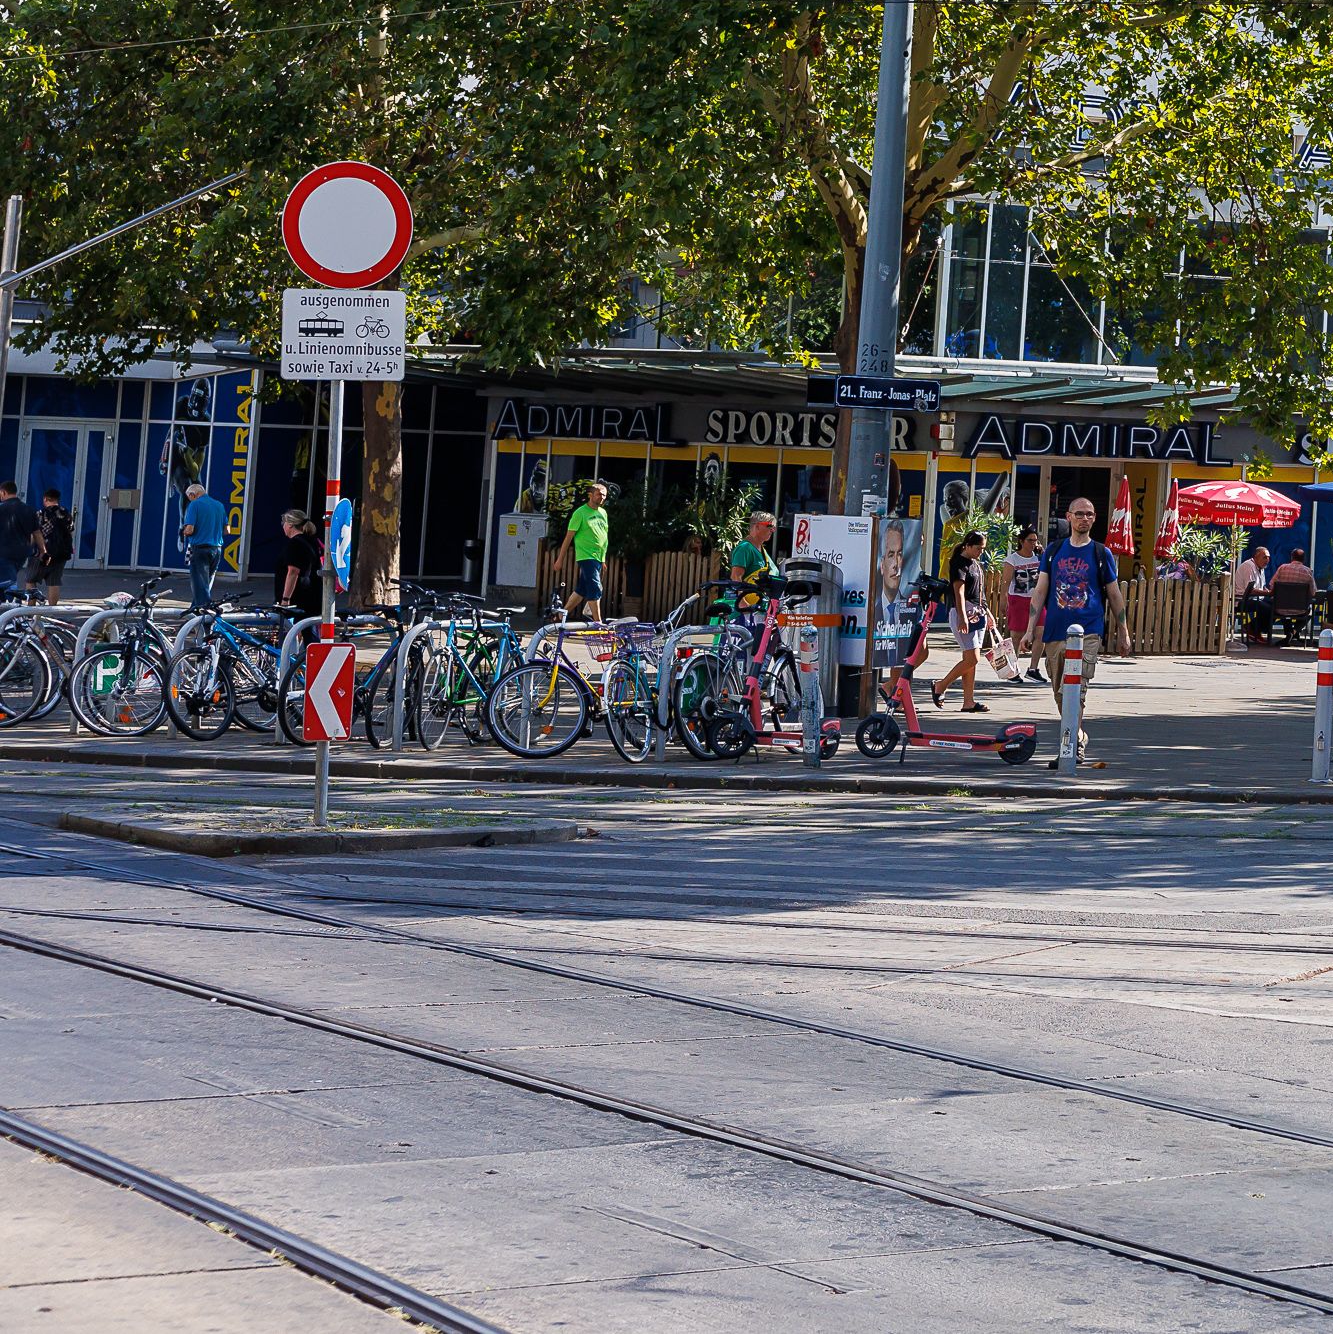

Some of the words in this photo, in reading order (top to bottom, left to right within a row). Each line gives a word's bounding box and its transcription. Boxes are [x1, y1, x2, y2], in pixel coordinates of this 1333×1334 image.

[300, 296, 390, 308] ausgenommen
[286, 344, 296, 354] u.
[299, 341, 402, 356] Linienomnibusse
[288, 360, 324, 373] sowie
[328, 361, 352, 374] Taxi
[860, 359, 888, 372] 248
[494, 399, 686, 447] ADMIRAL
[705, 409, 911, 451] SPORTSR
[966, 414, 1233, 465] ADMIRAL
[224, 369, 255, 572] ADMIRAL
[1133, 478, 1146, 581] DMIRAL
[814, 548, 843, 565] Starke
[842, 616, 862, 636] en.
[876, 620, 914, 638] Sicherheit
